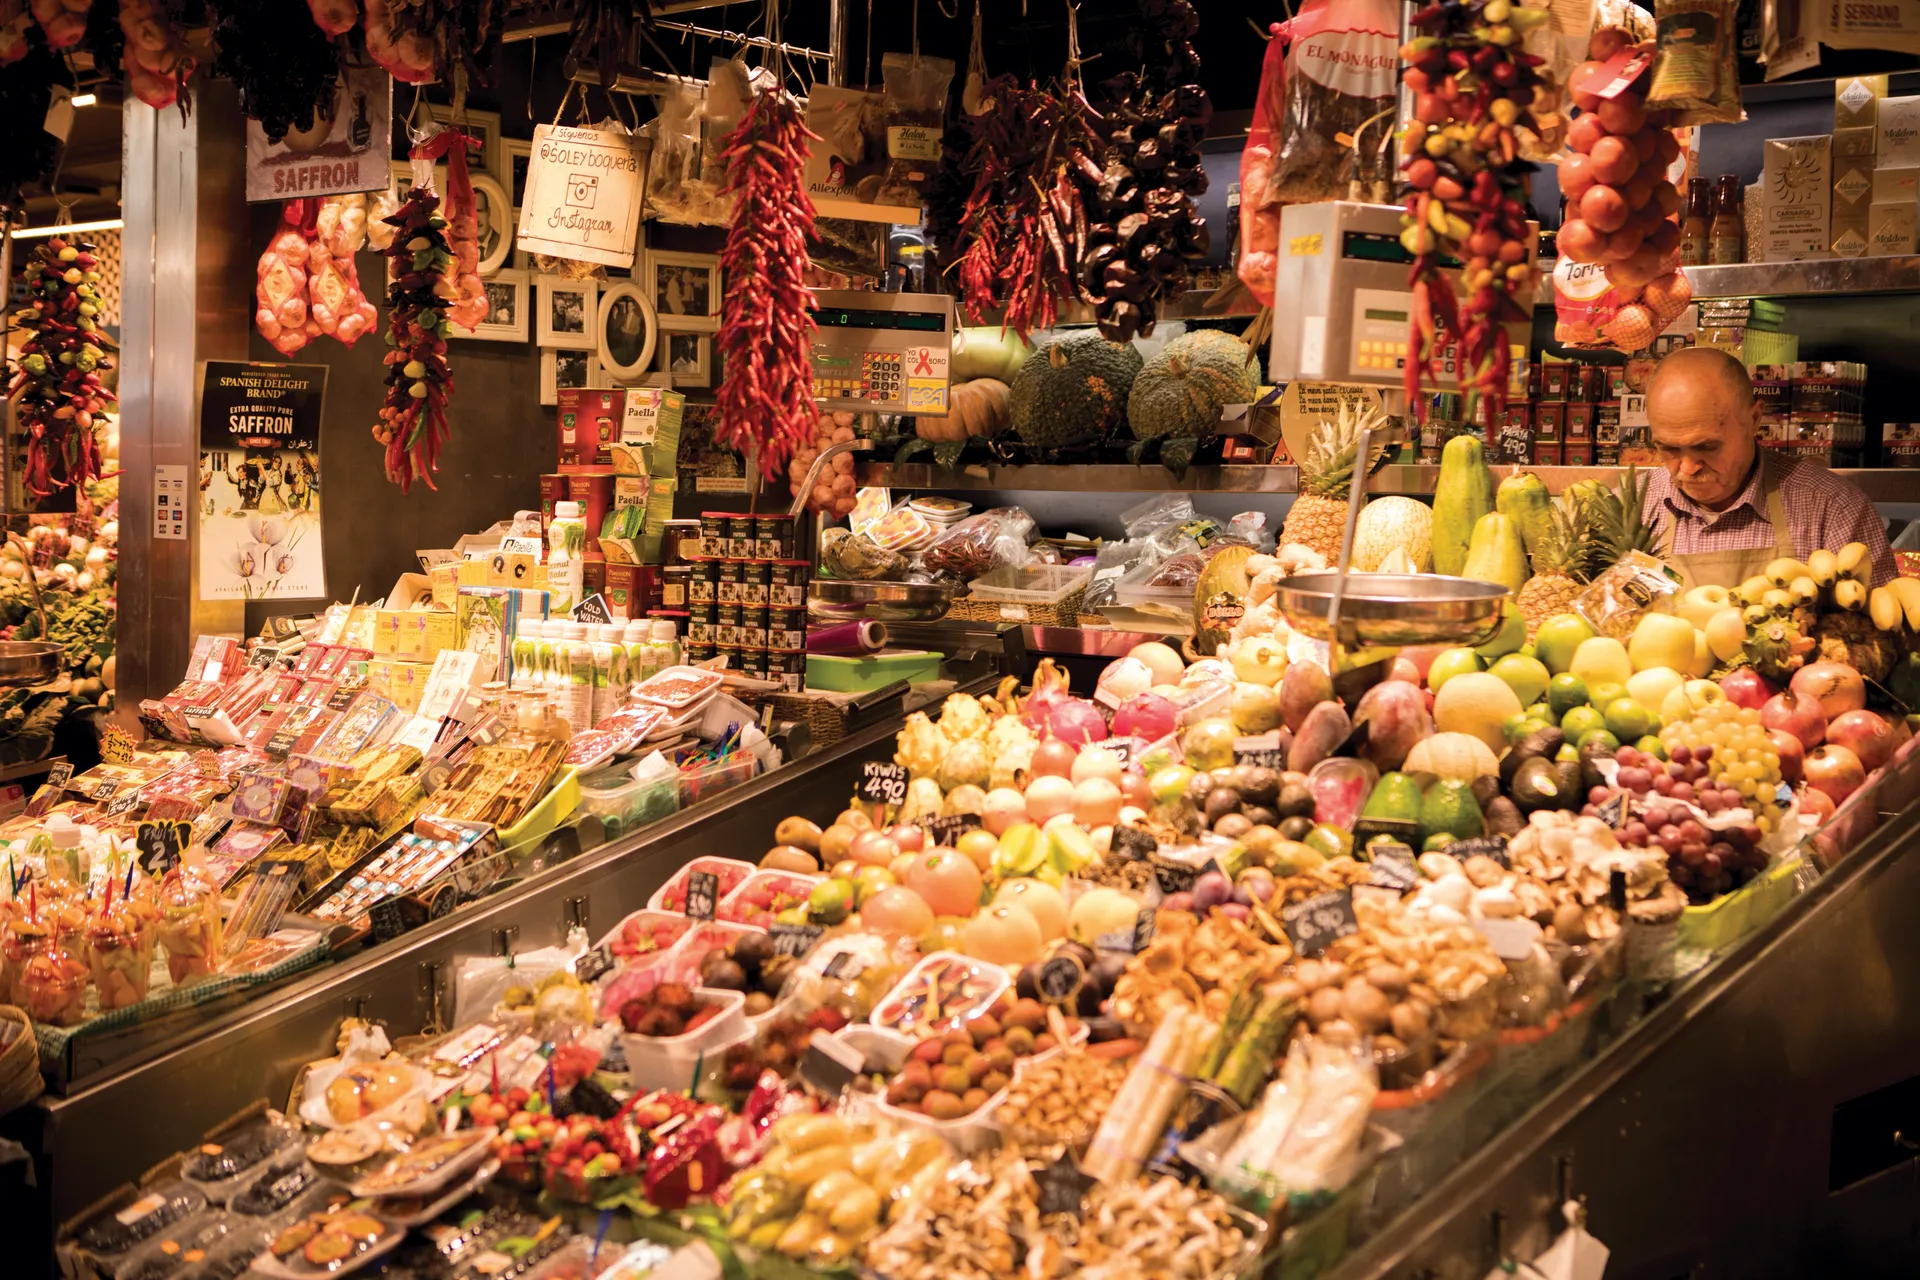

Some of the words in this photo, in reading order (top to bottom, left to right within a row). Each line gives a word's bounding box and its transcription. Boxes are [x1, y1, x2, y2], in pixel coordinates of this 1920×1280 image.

[1845, 4, 1900, 21] SERRANO
[1307, 45, 1324, 58] EL
[1328, 49, 1395, 70] MONAGUI
[1842, 91, 1873, 100] Maldon
[1884, 128, 1918, 139] Maldon
[273, 161, 359, 193] SAFFRON
[1838, 181, 1869, 191] Maldon
[1776, 209, 1815, 218] CARNAROLI
[547, 207, 615, 242] Instagram
[1875, 234, 1909, 243] Maldon
[1836, 242, 1867, 251] Maldon
[841, 314, 848, 324] 0
[907, 349, 916, 357] YO
[220, 376, 262, 388] SPANISH
[263, 379, 309, 390] DELIGHT
[1753, 387, 1781, 396] PAELLA
[1801, 384, 1832, 394] PAELLA
[230, 404, 250, 414] EXTRA
[250, 404, 277, 413] QUALITY
[277, 406, 294, 416] PURE
[627, 407, 655, 418] Paella
[228, 414, 294, 435] SAFFRON
[1501, 425, 1529, 440] PAPAYA
[287, 438, 313, 449] زعفران
[1796, 446, 1825, 456] PAELLA
[1891, 446, 1920, 456] PAELLA
[617, 494, 645, 505] Paella
[513, 540, 533, 553] Paella
[583, 601, 601, 615] COLD
[1208, 606, 1244, 618] BOLLO
[184, 707, 212, 715] SAFFRON
[864, 763, 906, 780] KIWIS
[864, 777, 906, 799] 4.90
